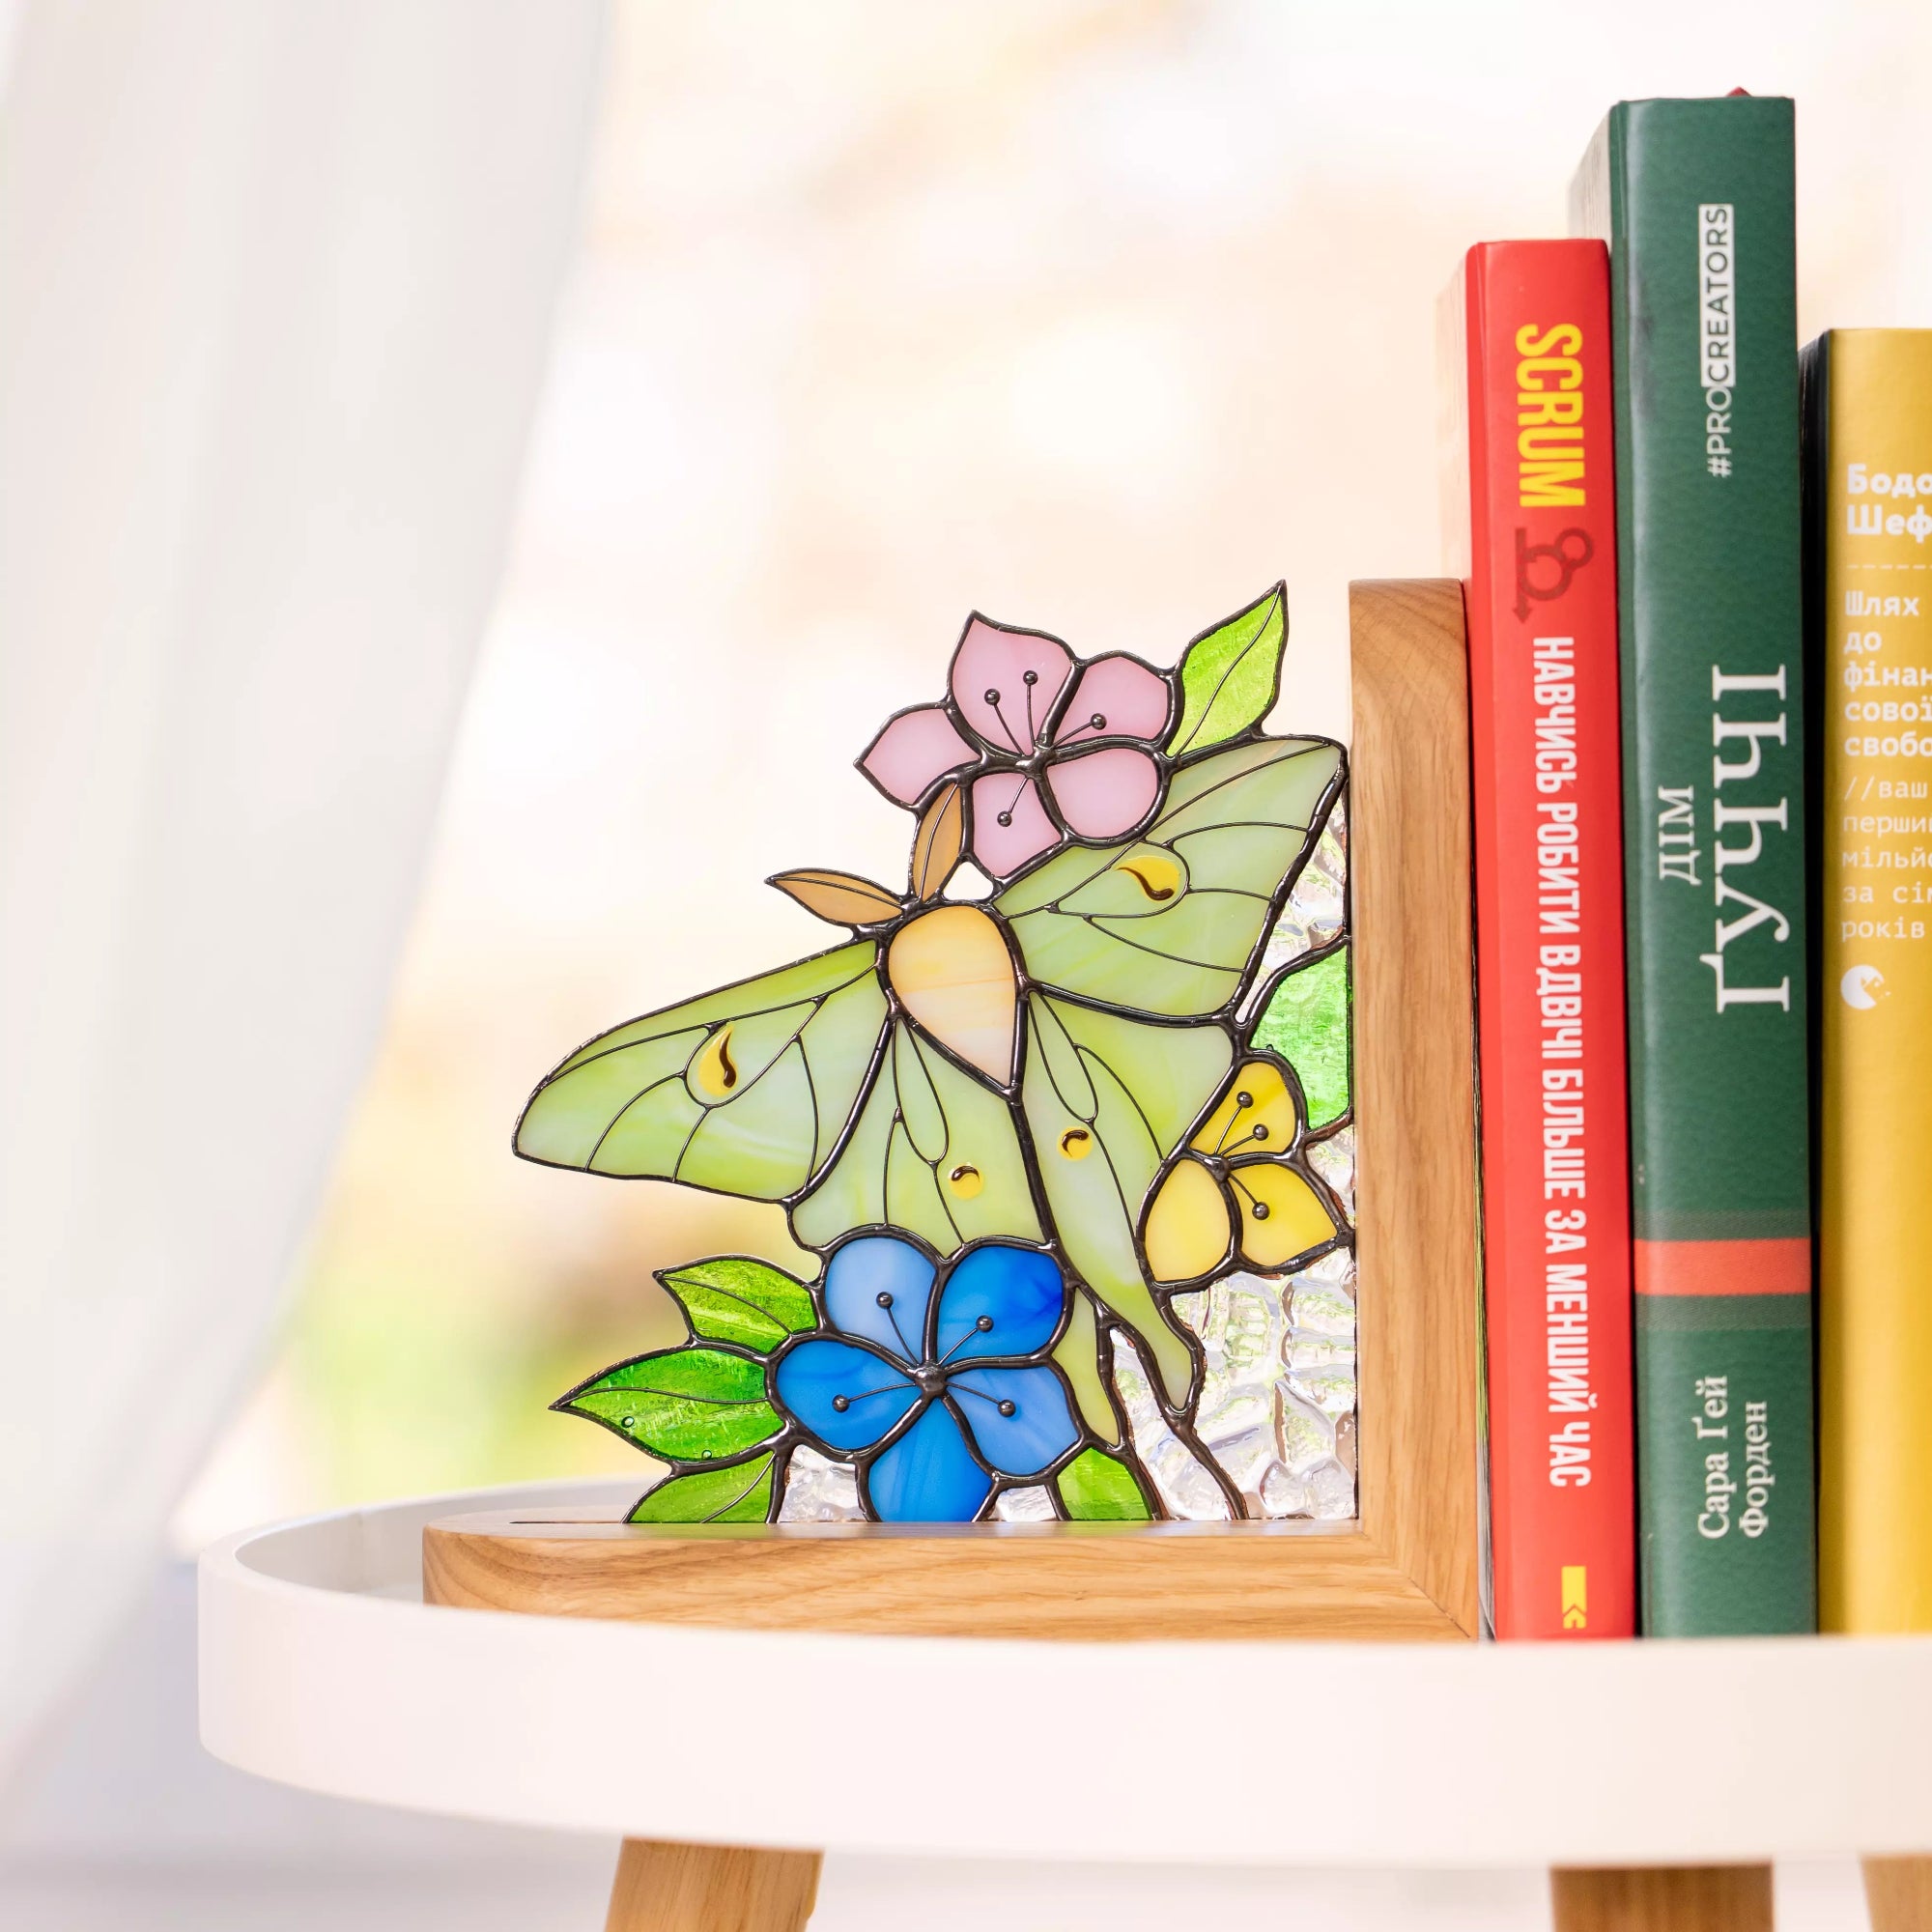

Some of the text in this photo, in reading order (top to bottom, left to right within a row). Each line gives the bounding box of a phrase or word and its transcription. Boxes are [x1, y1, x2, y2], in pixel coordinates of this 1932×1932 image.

[1702, 204, 1736, 477] #PROCREATORS
[1515, 324, 1585, 507] SCRUM
[1847, 464, 1932, 498] Бодо
[1847, 504, 1932, 544] Шеф
[1845, 590, 1919, 617] Шлях
[1844, 631, 1883, 655] до
[1657, 785, 1701, 886] ДІМ
[1696, 665, 1789, 1013] ҐУЧЧІ
[1843, 815, 1932, 838] перши
[1842, 845, 1932, 868] мільй
[1842, 880, 1932, 904] за сі
[1841, 916, 1925, 943] років
[1533, 637, 1597, 1487] НАВЧИСЬ РОБИТИ ВДВІЧІ БІЛЬШЕ ЗА МЕНШИЙ ЧАС
[1690, 1376, 1738, 1540] Сара Ґей
[1738, 1402, 1776, 1538] Форден
